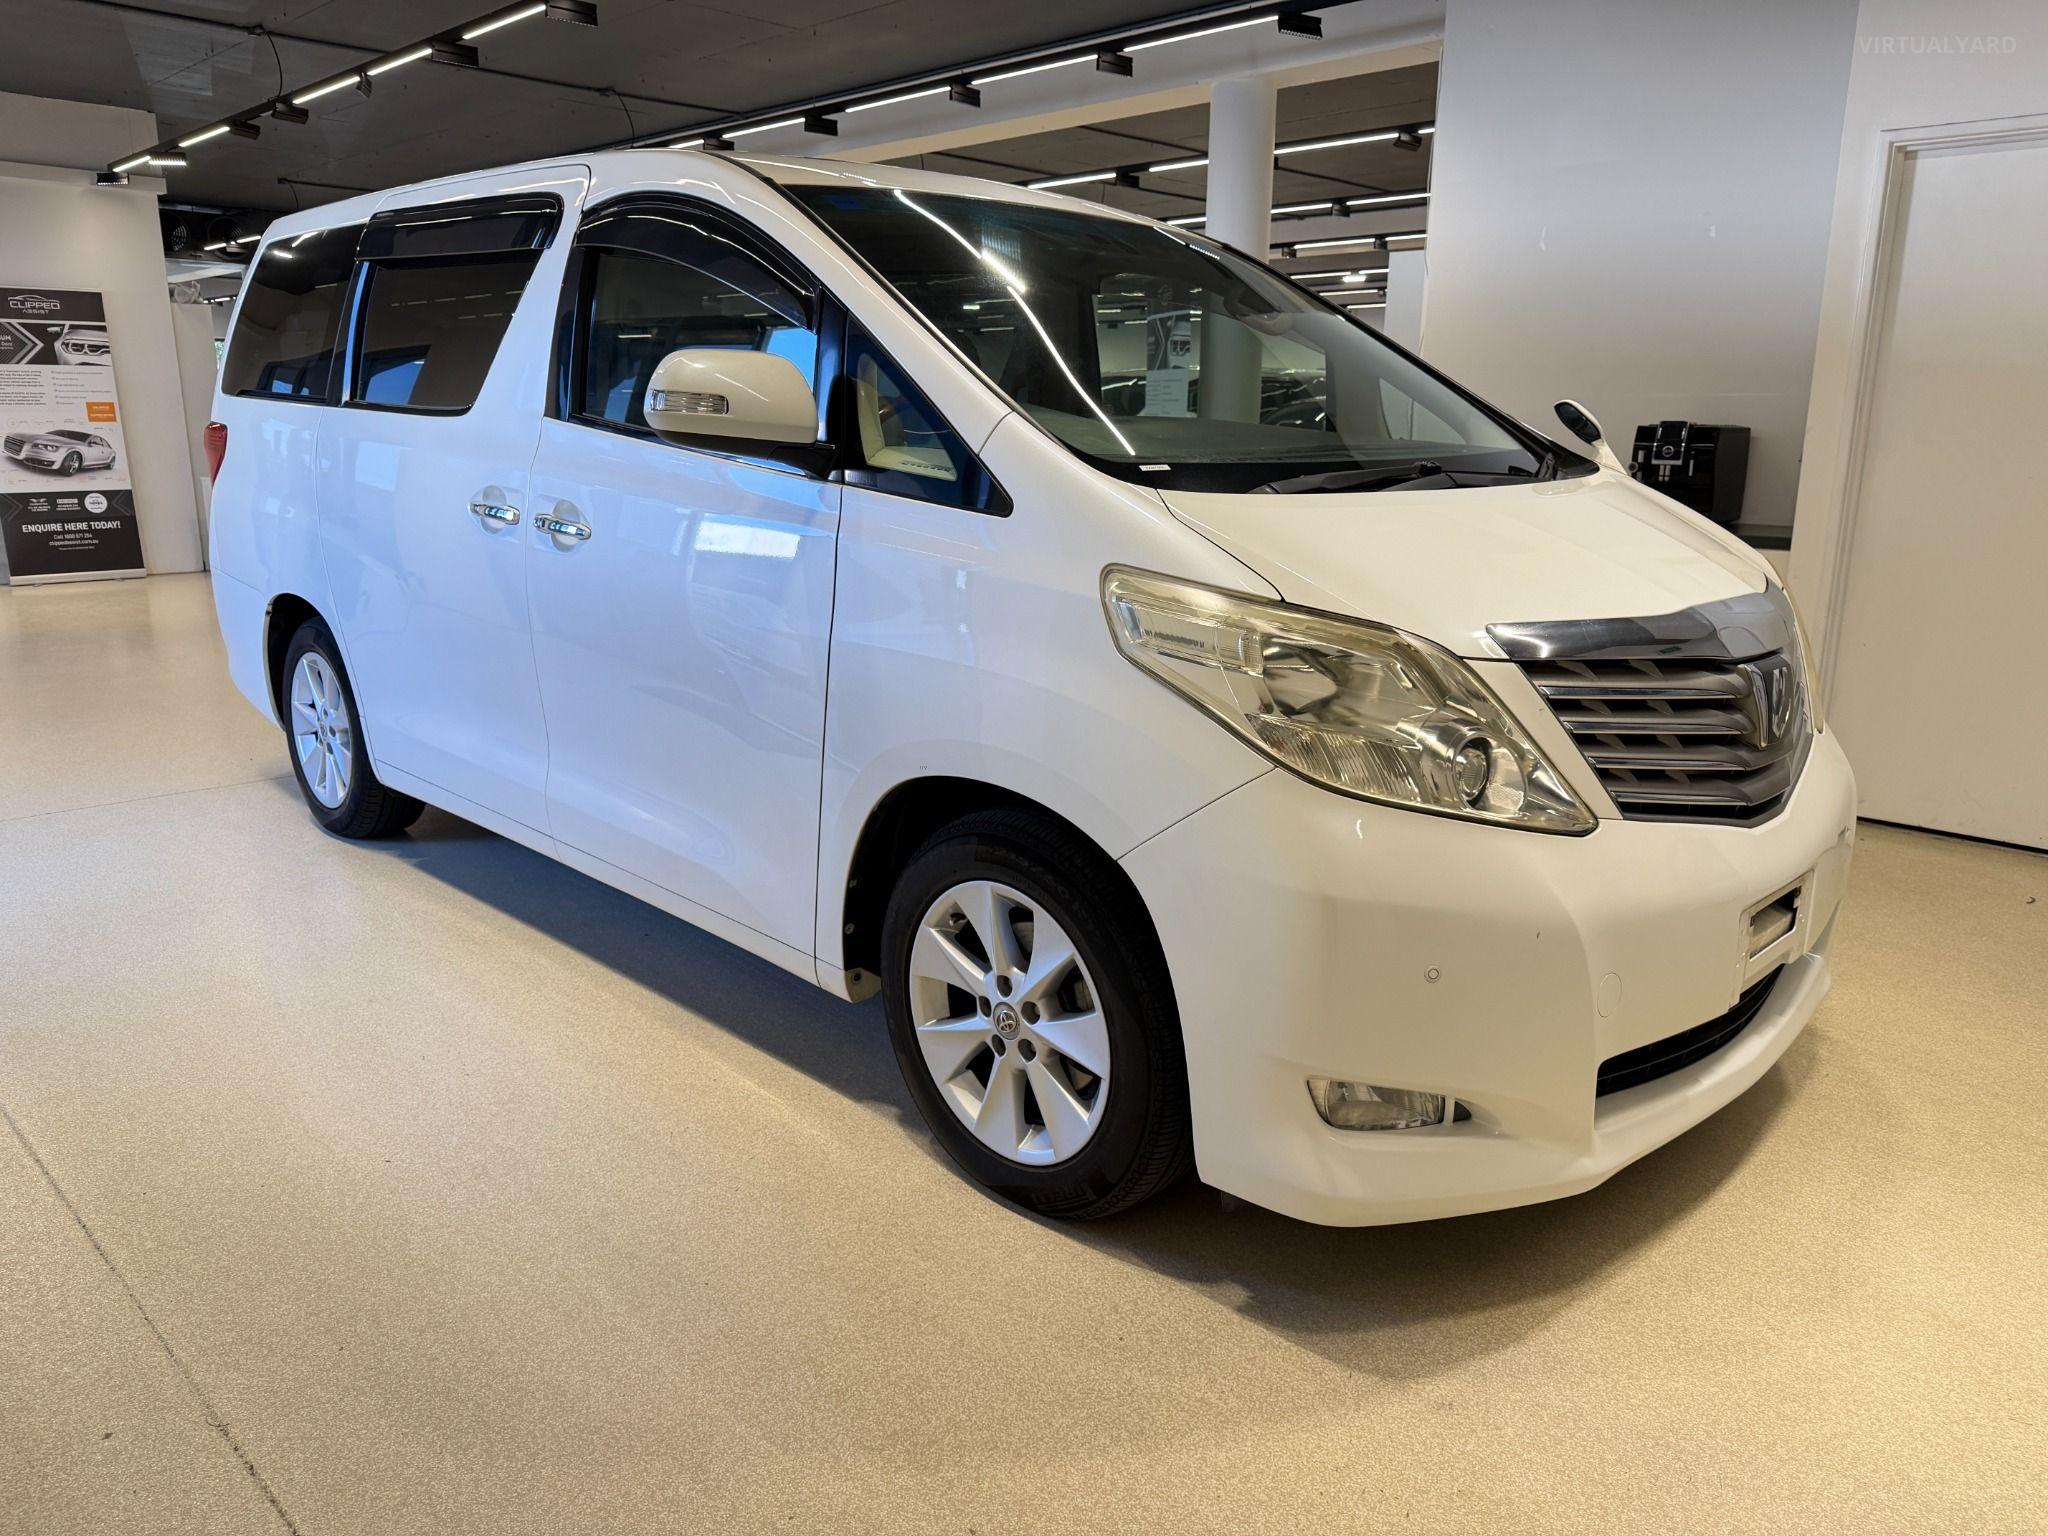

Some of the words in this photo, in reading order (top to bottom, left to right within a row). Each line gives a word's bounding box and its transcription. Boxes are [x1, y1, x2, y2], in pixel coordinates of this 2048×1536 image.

[9, 300, 60, 310] CLIPPED
[22, 523, 63, 533] ENQUIRE
[64, 522, 89, 531] HERE
[89, 520, 121, 530] TODAY!
